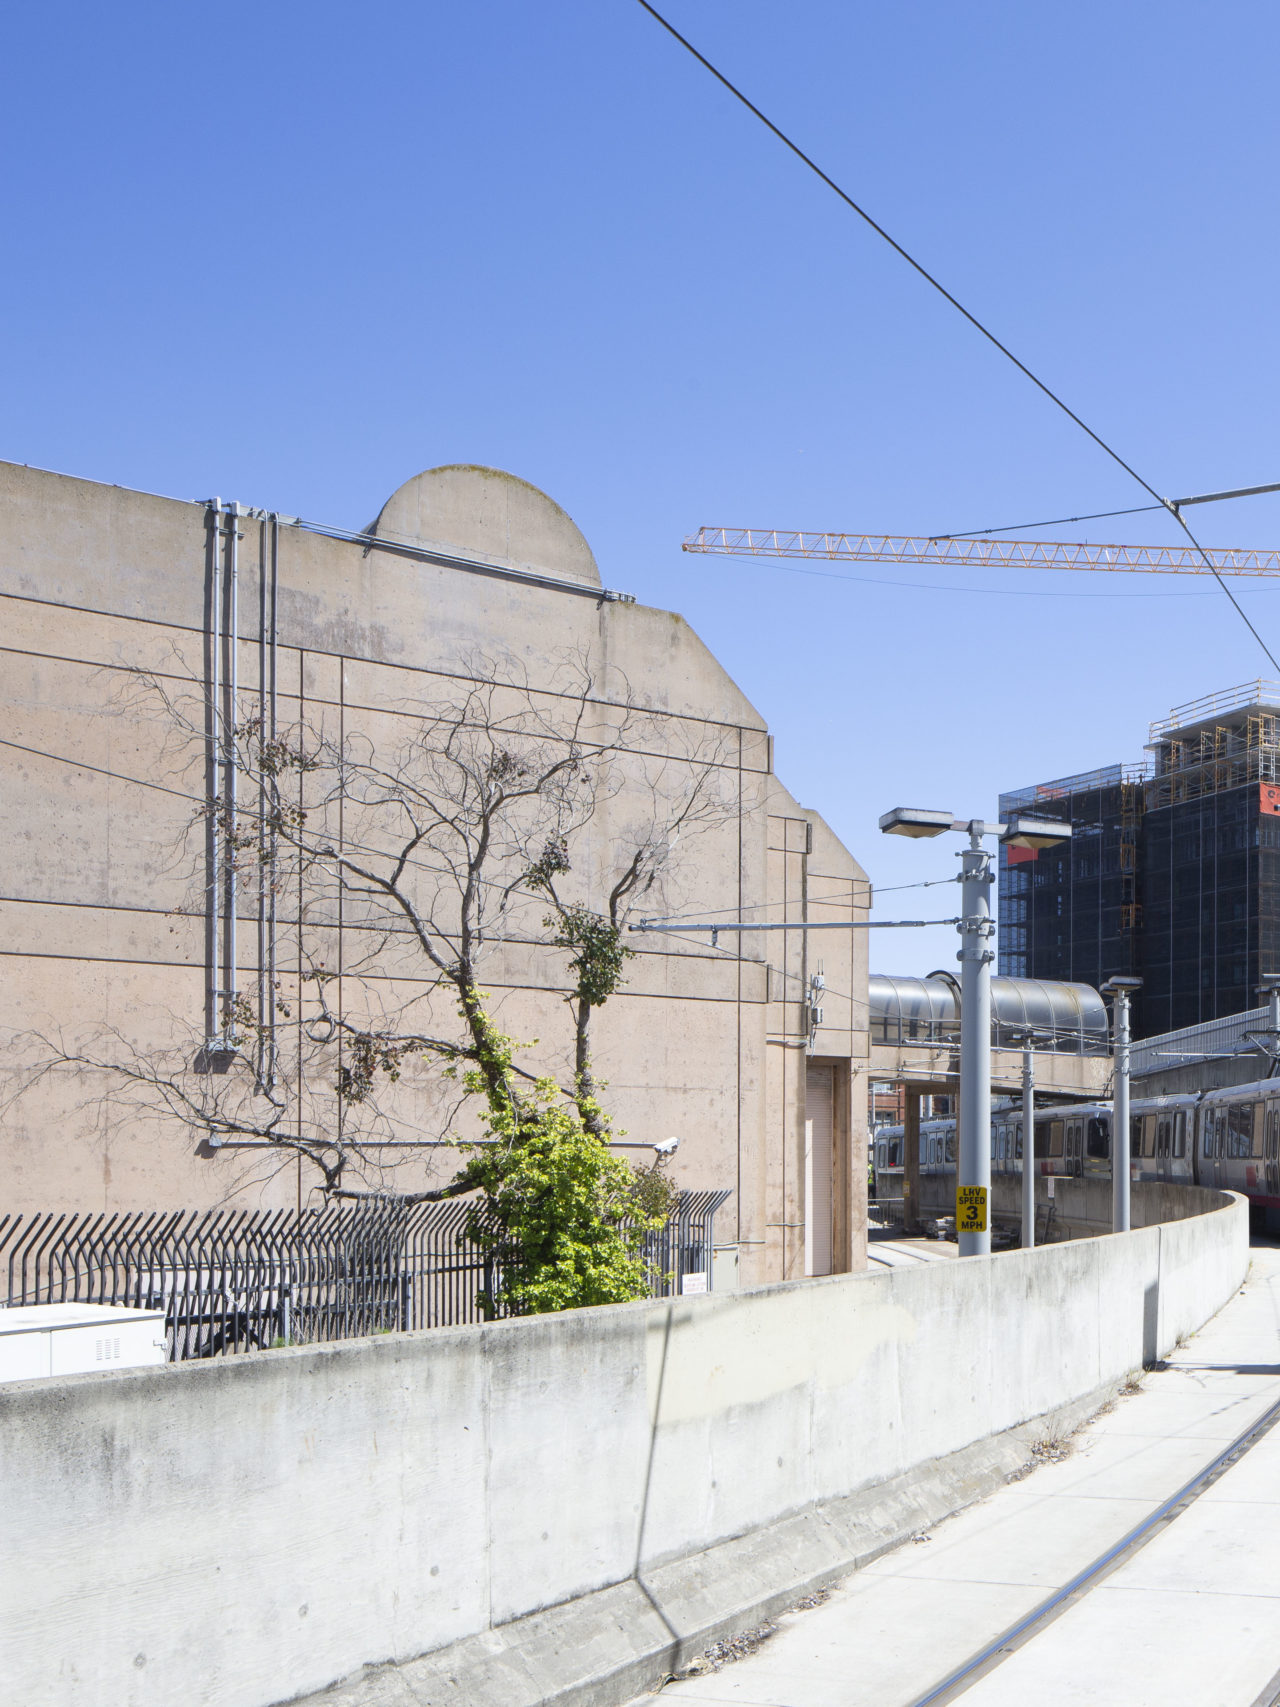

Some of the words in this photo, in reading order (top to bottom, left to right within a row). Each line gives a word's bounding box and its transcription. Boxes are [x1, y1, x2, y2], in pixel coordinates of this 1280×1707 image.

[963, 1188, 981, 1196] LRV
[959, 1196, 985, 1204] SPEED
[966, 1205, 978, 1220] 3
[961, 1221, 983, 1229] MPH
